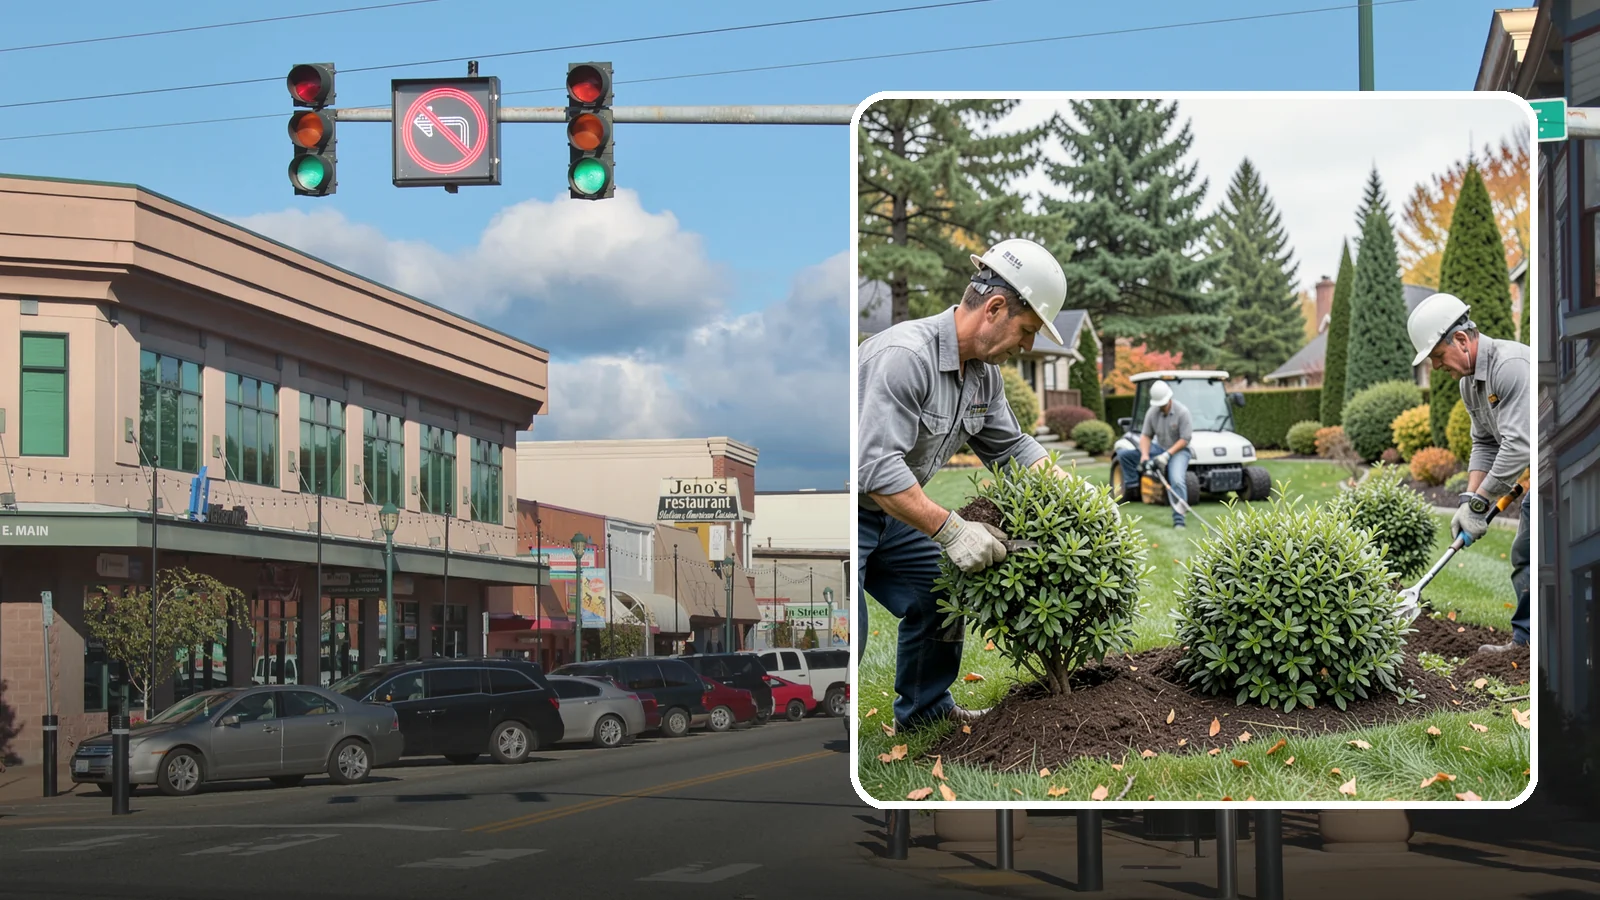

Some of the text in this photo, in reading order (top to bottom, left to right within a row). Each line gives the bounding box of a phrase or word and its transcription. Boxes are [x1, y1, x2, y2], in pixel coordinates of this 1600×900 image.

[670, 480, 727, 494] Jeno's
[665, 496, 730, 508] restaurant
[659, 510, 682, 520] Italian
[686, 510, 714, 519] American
[715, 510, 737, 519] Cuisine
[2, 526, 48, 536] E. MAIN
[786, 608, 828, 616] in Street
